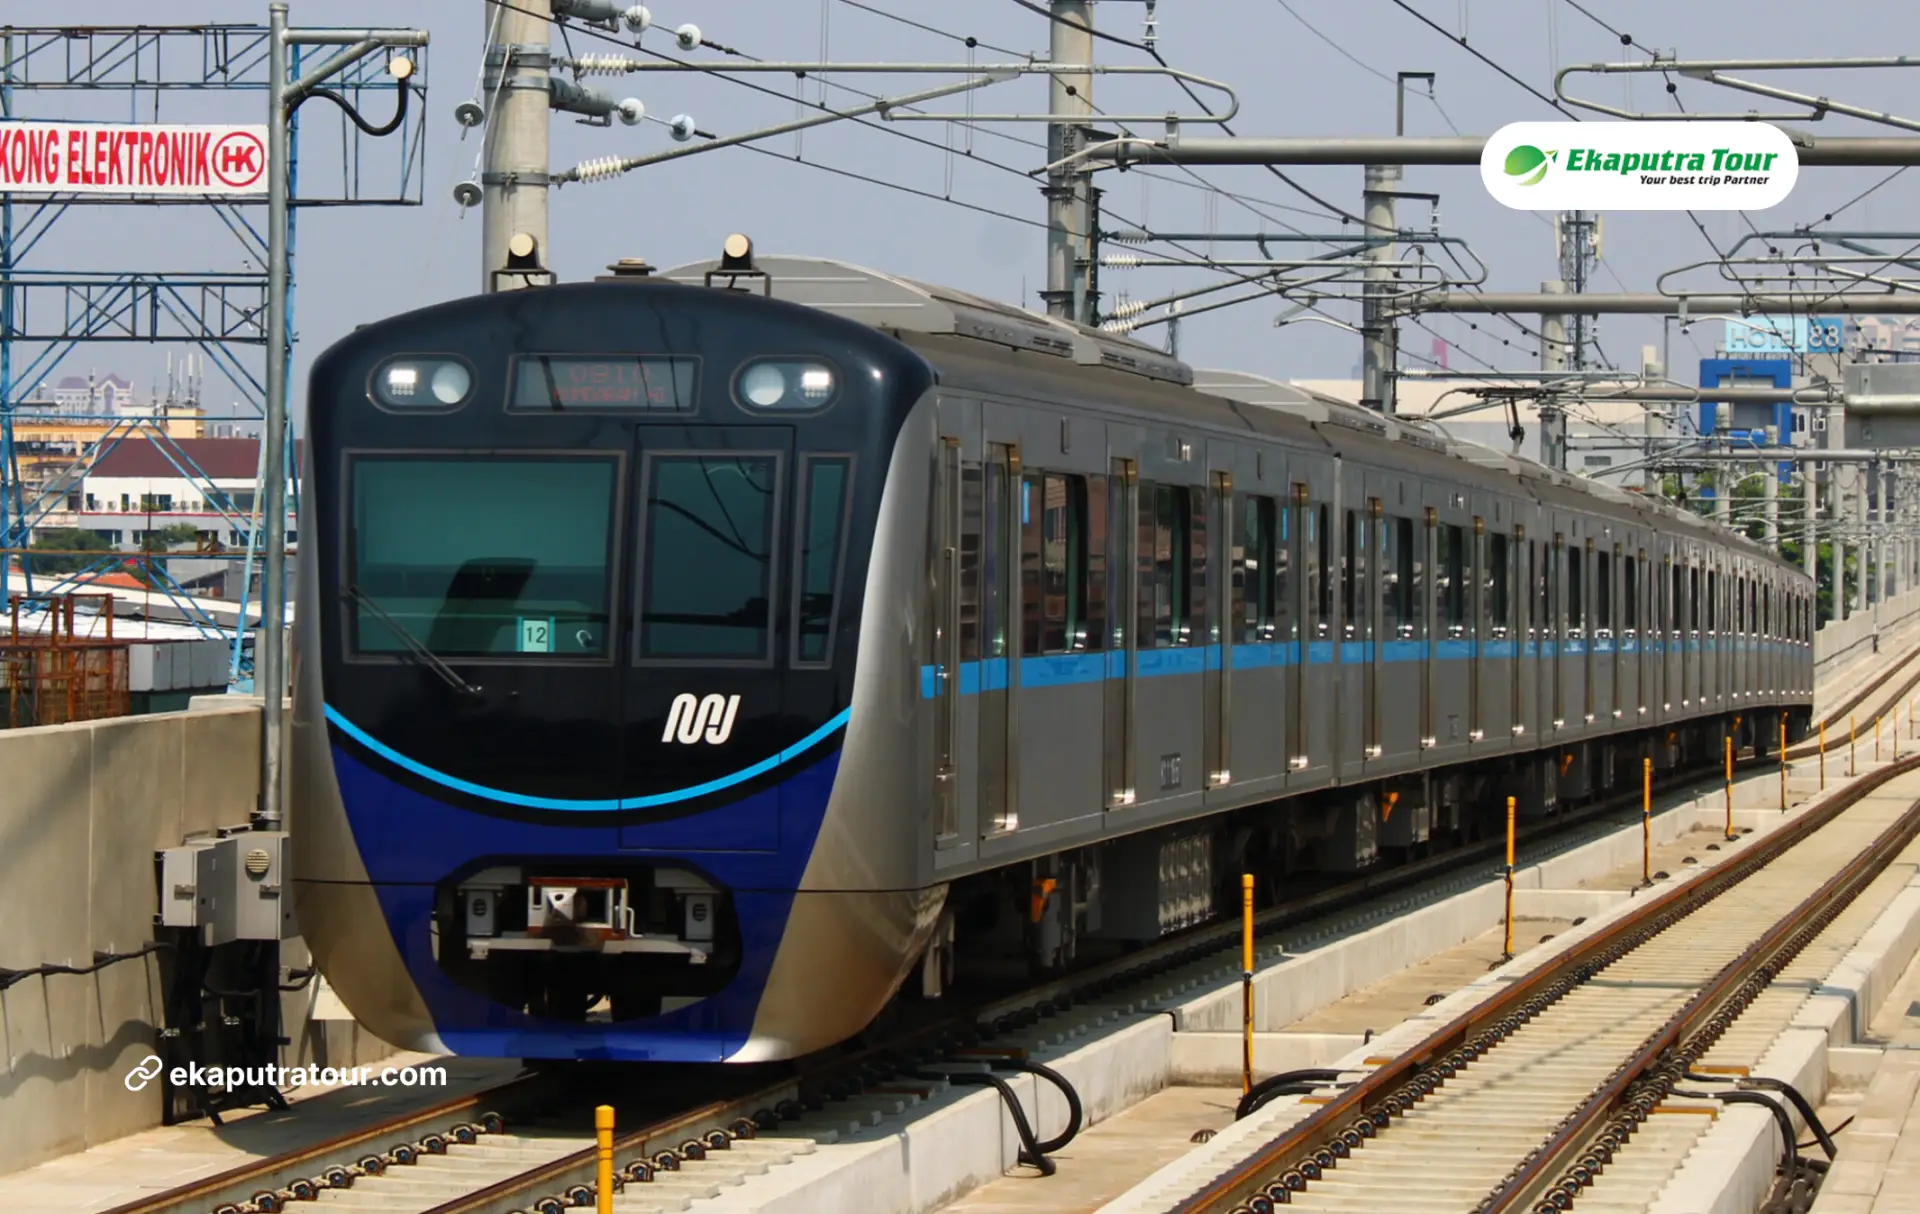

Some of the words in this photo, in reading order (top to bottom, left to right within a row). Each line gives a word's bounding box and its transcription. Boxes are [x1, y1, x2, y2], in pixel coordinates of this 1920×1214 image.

[0, 129, 60, 185] KONG
[68, 130, 212, 186] ELEKTRONIK
[222, 145, 257, 173] HK
[1730, 325, 1804, 349] HOTEL
[1808, 323, 1840, 349] 88
[526, 626, 547, 644] 12
